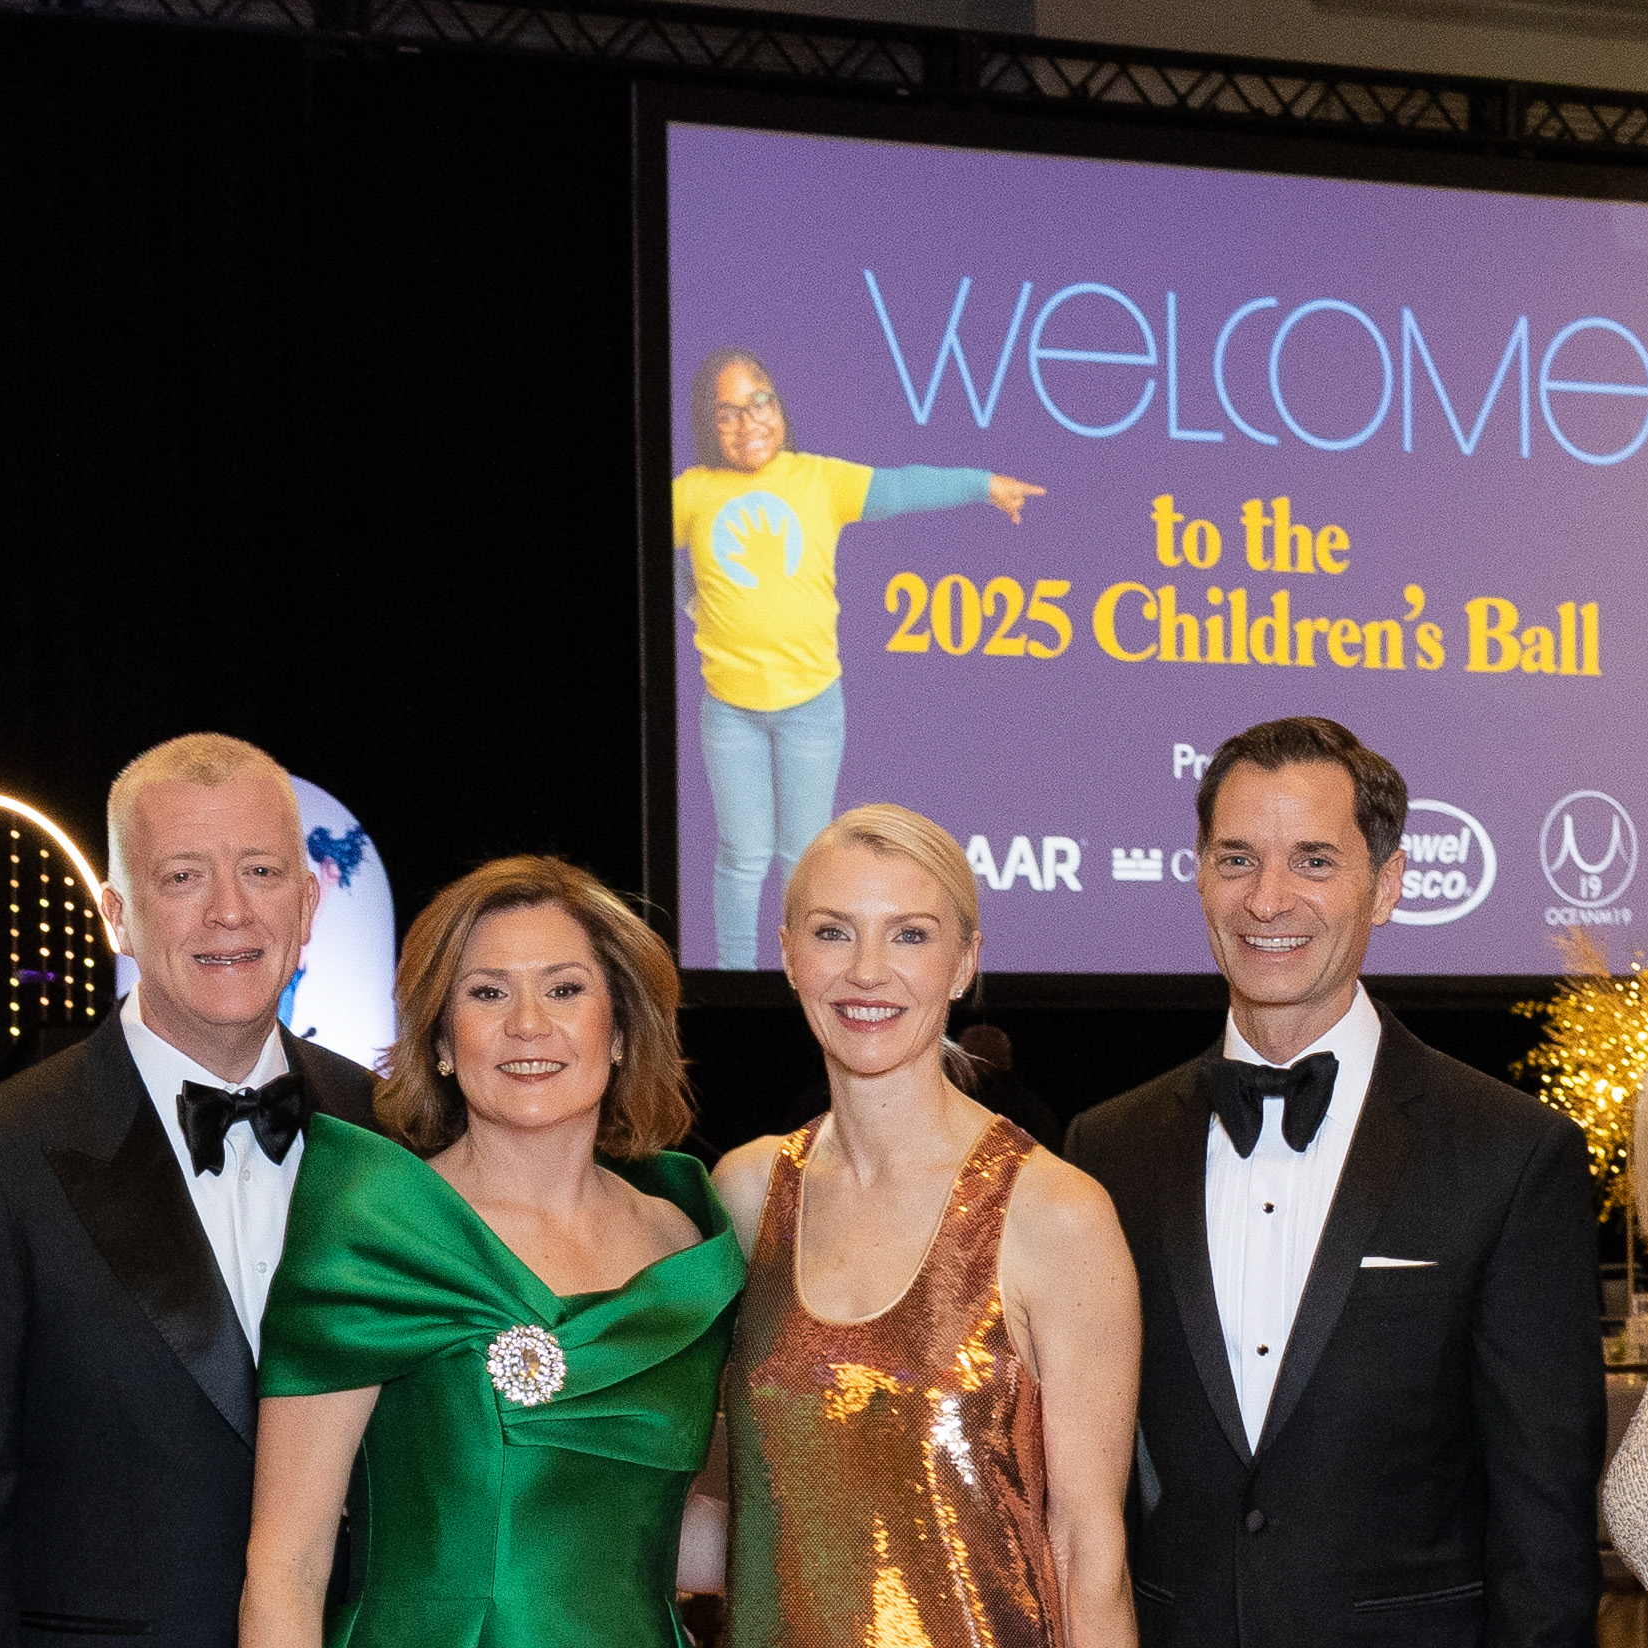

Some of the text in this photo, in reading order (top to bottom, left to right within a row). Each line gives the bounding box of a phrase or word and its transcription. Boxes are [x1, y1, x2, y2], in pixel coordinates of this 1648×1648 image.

[1152, 495, 1350, 574] to the
[885, 573, 1601, 676] 2025 Children's Ball
[1401, 827, 1471, 864] ewel
[1401, 870, 1468, 900] sco
[1580, 874, 1602, 899] 19
